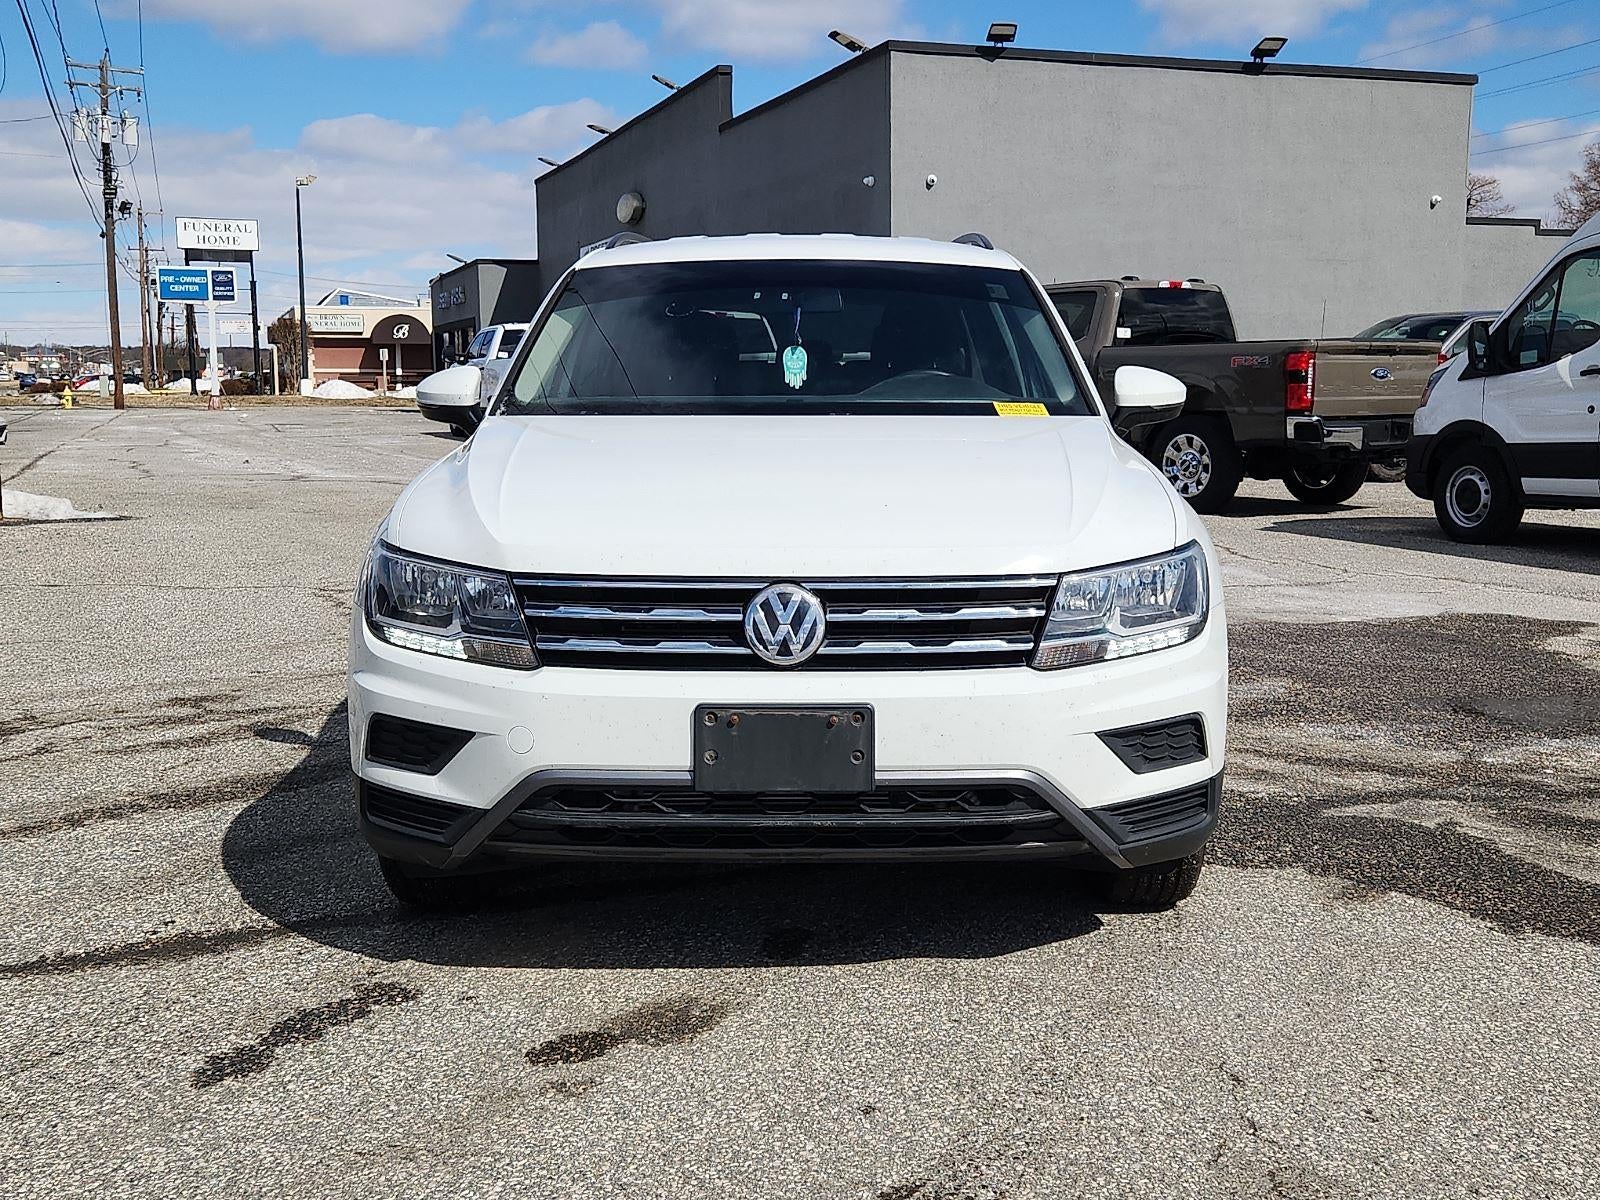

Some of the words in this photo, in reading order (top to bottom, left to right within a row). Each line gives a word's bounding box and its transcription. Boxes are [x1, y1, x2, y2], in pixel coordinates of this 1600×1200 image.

[183, 221, 252, 233] FUNERAL
[196, 234, 241, 246] HOME
[169, 284, 200, 292] CENTER
[392, 323, 411, 339] B
[1230, 355, 1270, 368] FX4
